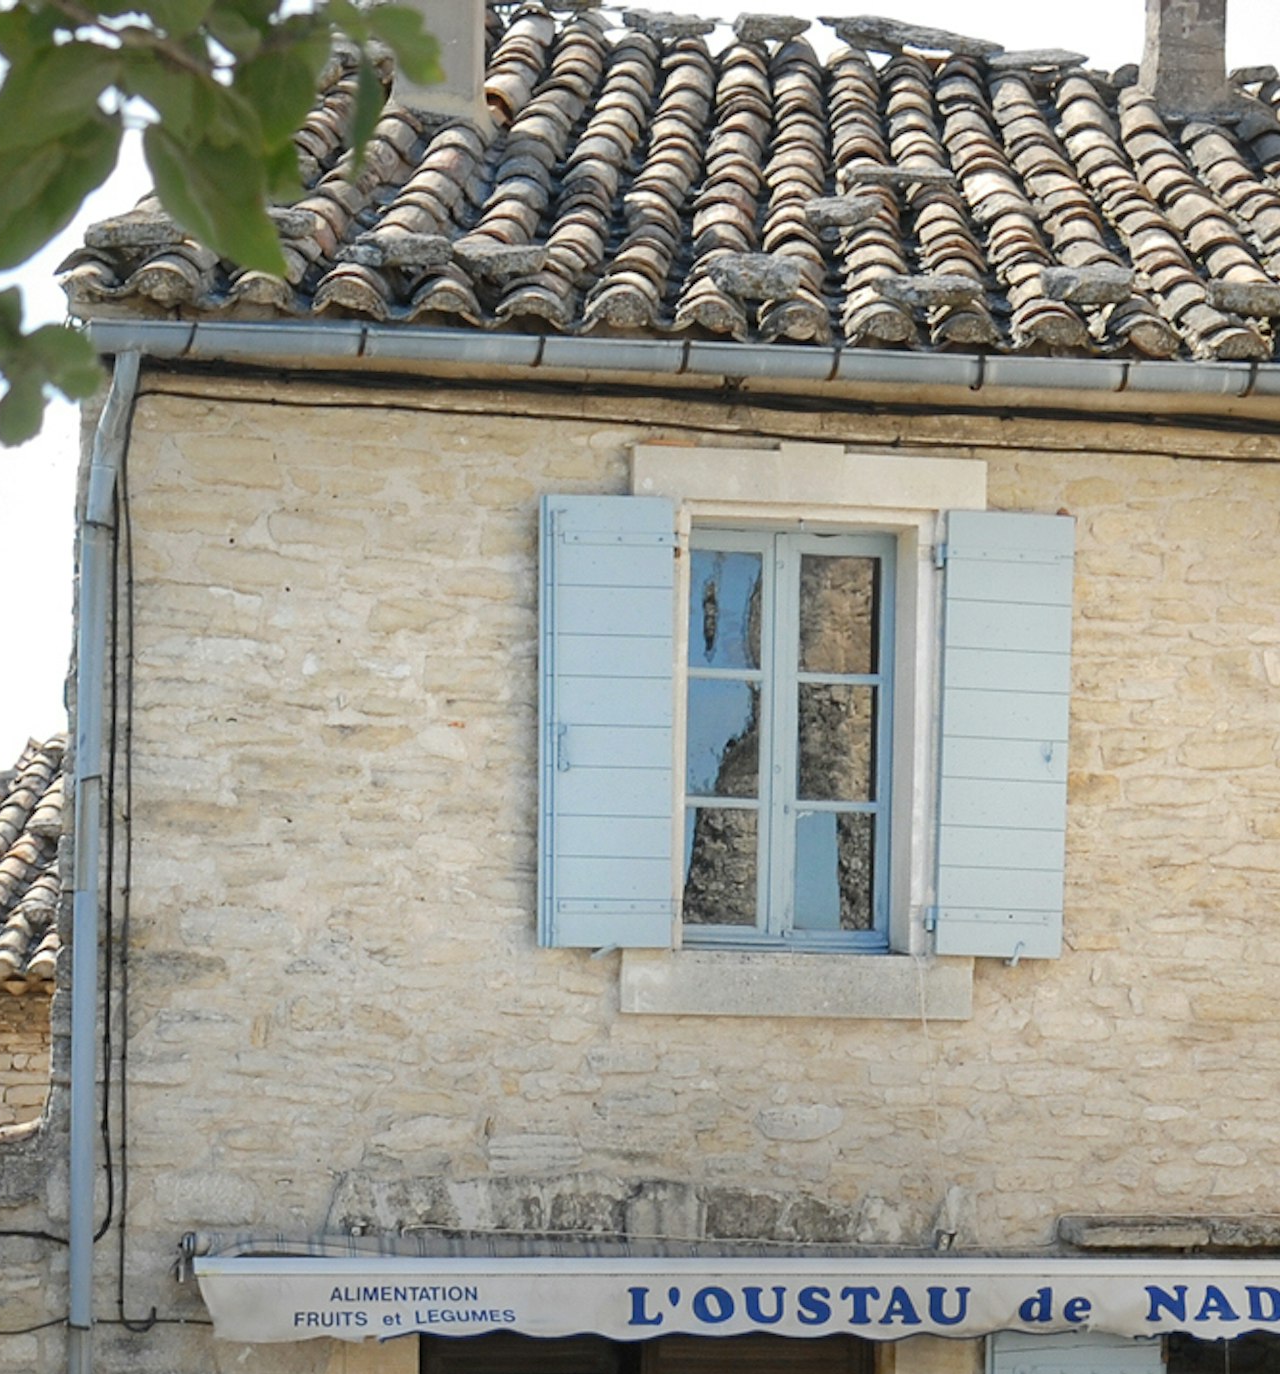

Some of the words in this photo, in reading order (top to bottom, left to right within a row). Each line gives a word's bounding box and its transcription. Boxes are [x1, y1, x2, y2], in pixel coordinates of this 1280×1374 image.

[329, 1286, 478, 1302] ALIMENTATION
[627, 1285, 971, 1326] L'OUSTAU
[1018, 1286, 1093, 1324] de
[293, 1311, 369, 1328] FRUITS
[382, 1313, 402, 1327] et
[414, 1308, 517, 1325] LEGUMES
